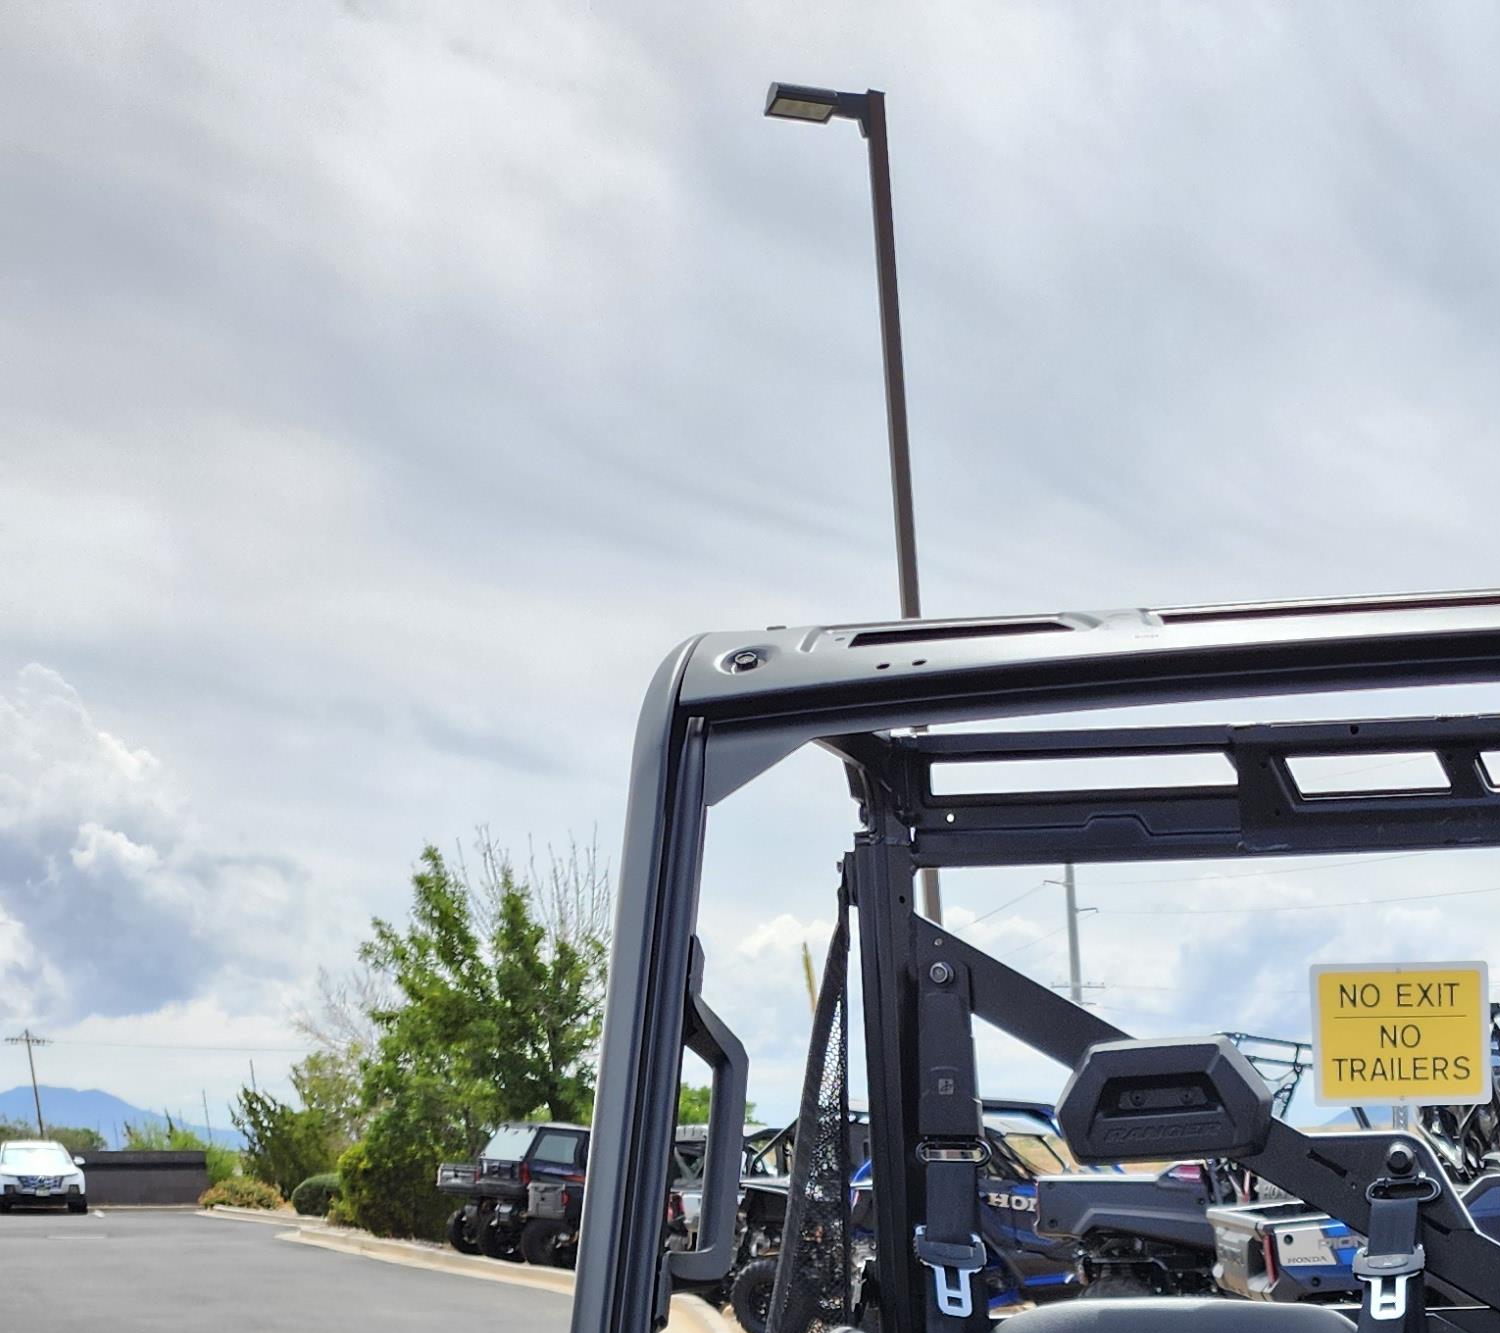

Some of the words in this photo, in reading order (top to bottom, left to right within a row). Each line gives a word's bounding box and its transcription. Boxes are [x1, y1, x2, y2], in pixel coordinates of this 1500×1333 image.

[1339, 984, 1380, 1008] NO
[1396, 983, 1460, 1007] EXIT
[1380, 1024, 1421, 1049] NO
[1332, 1056, 1471, 1081] TRAILERS
[1103, 1121, 1223, 1145] RANGER
[1287, 1255, 1328, 1264] HONDA
